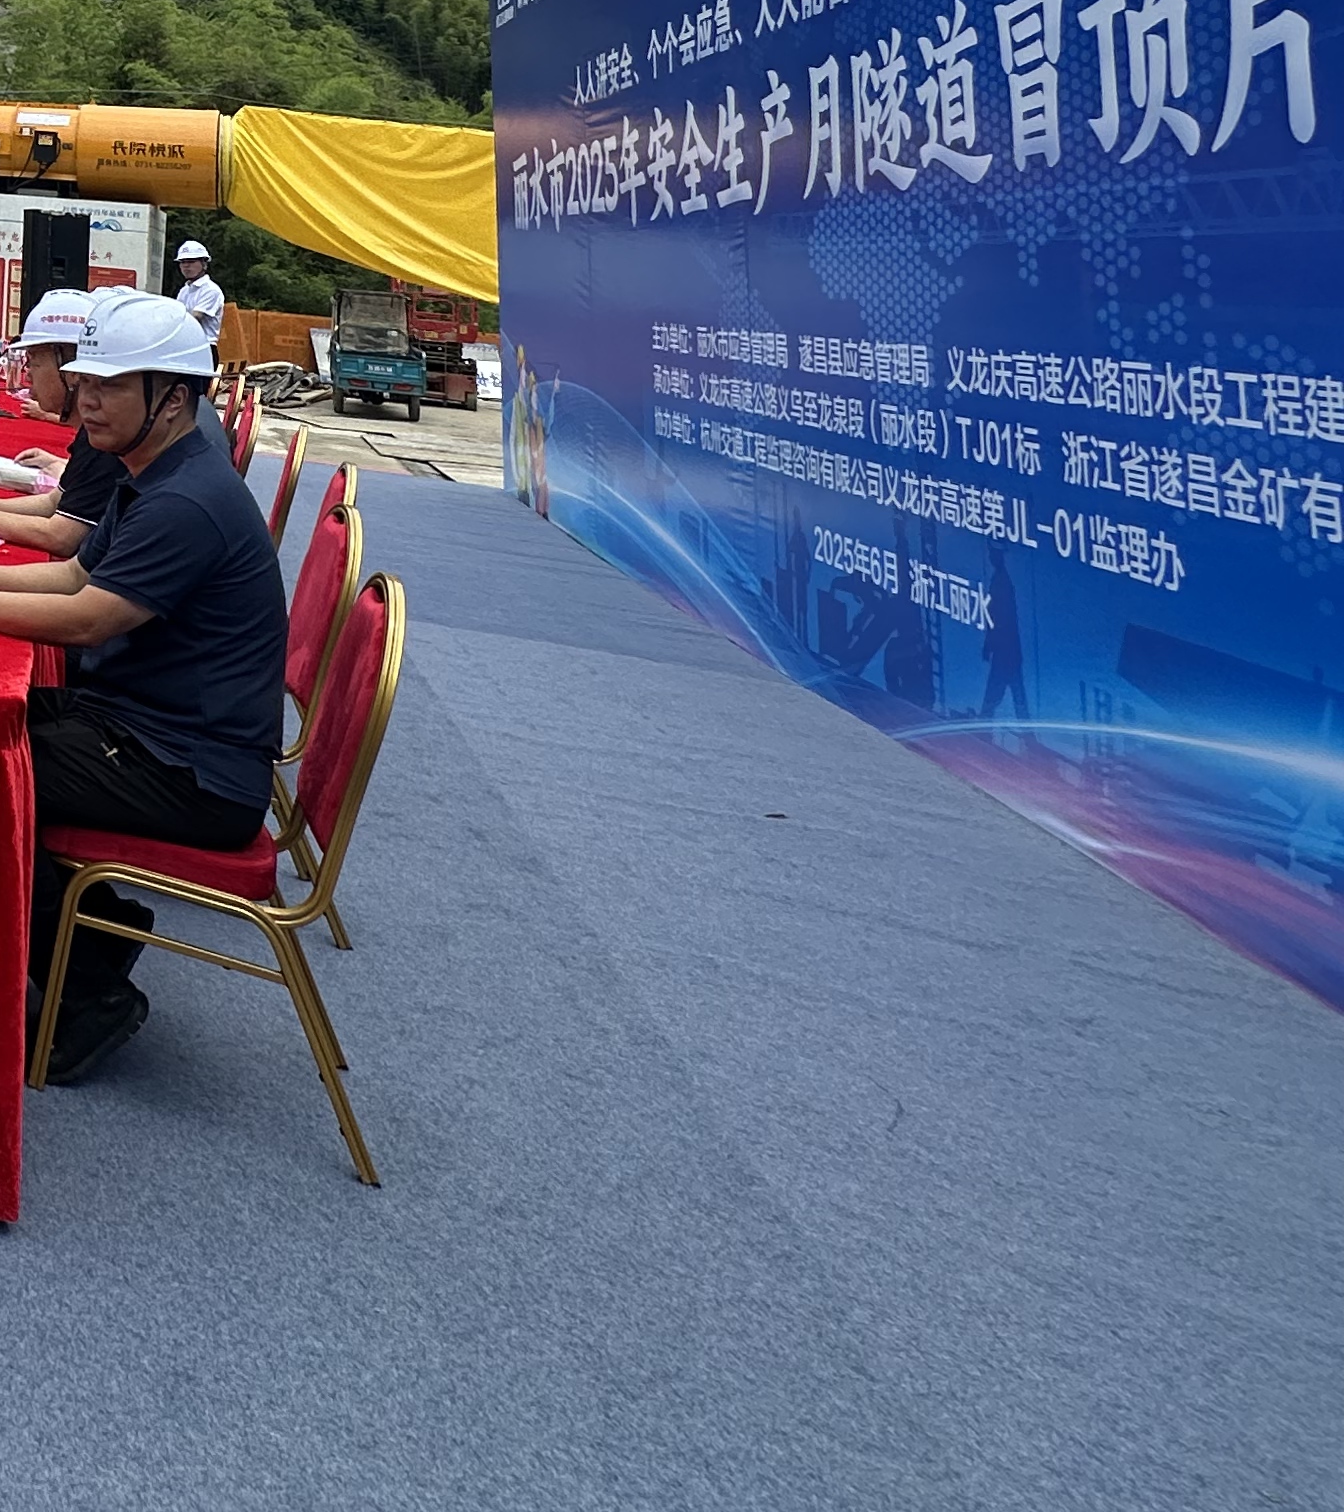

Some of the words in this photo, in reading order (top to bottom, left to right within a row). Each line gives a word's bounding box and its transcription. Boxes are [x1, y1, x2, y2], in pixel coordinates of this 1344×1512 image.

[798, 335, 930, 388] 遂昌县应急管理局
[1062, 431, 1344, 543] 浙江省遂昌金矿有
[814, 526, 900, 595] 2025年6月
[908, 562, 995, 630] 浙江丽水
